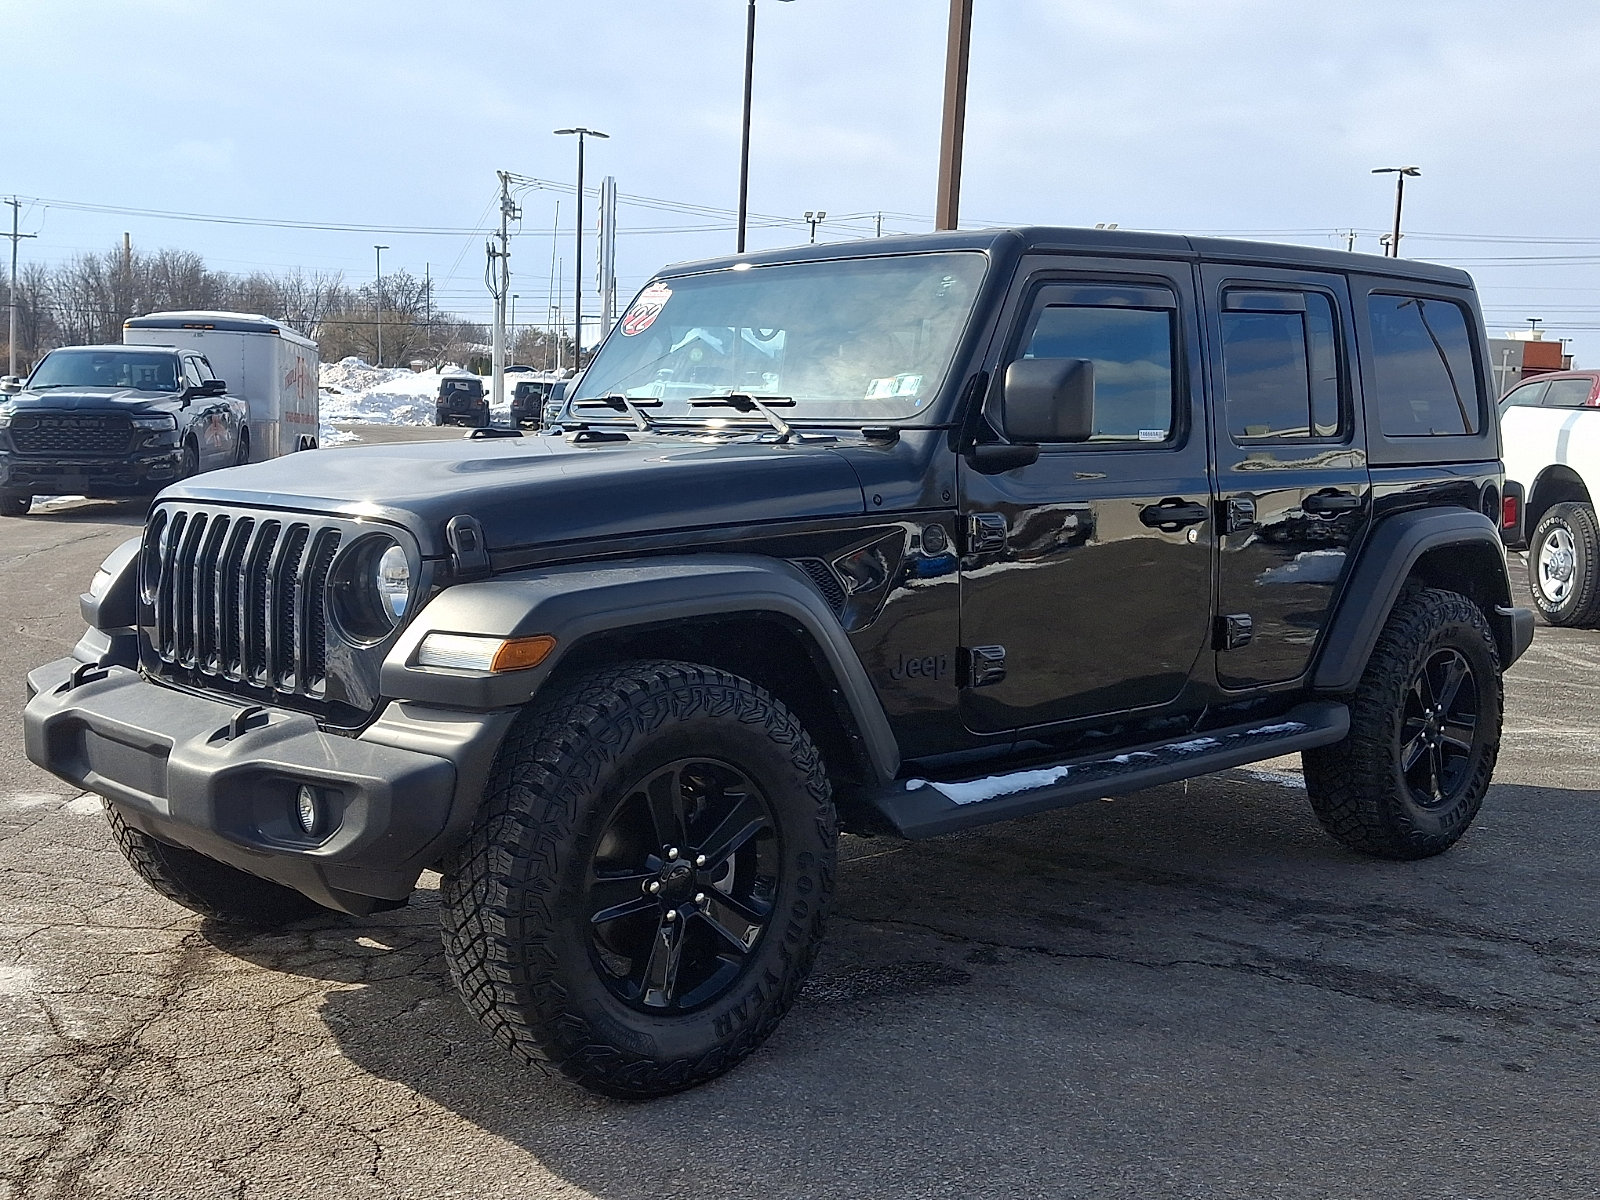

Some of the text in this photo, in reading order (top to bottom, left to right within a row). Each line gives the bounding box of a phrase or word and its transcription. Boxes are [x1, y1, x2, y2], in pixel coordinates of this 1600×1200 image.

[41, 419, 99, 427] RAM
[889, 653, 947, 681] Jeep
[713, 850, 815, 1040] GOODYEAR
